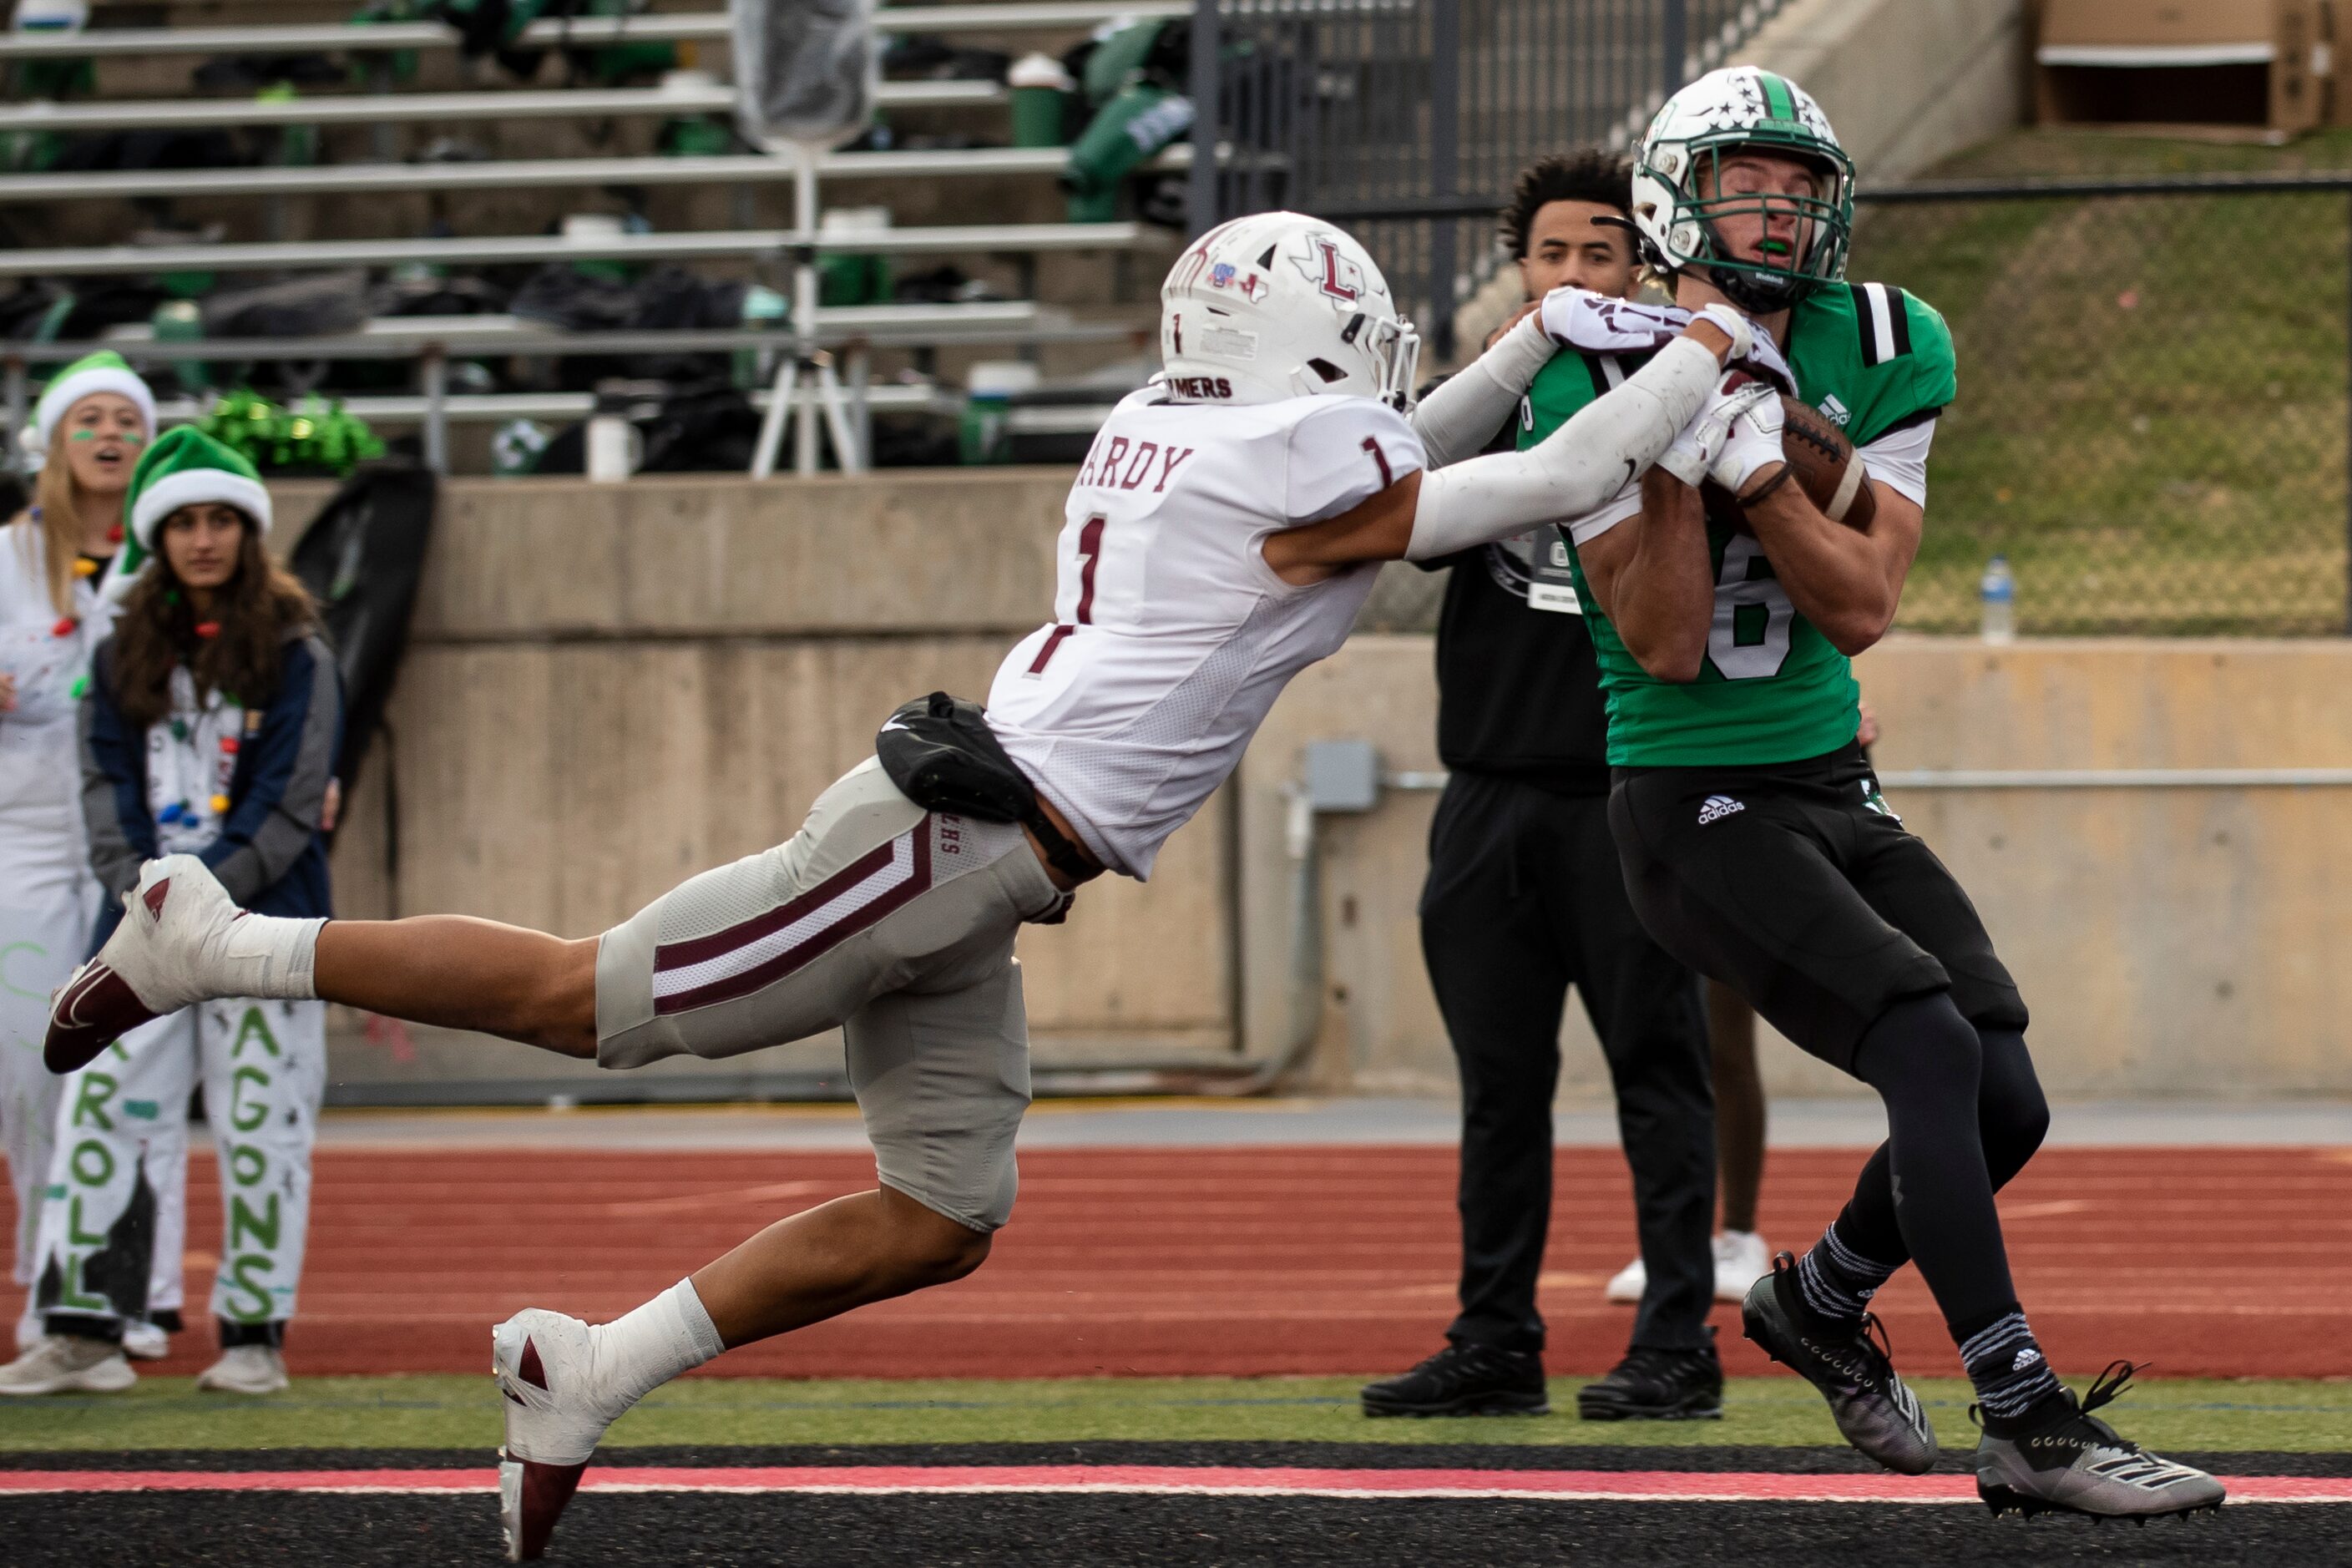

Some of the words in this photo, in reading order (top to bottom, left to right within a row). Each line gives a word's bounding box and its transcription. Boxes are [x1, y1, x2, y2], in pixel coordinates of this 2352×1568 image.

[1318, 240, 1358, 301] L
[1172, 312, 1182, 355] 1
[1168, 377, 1233, 399] MERS
[1358, 435, 1393, 488] 1
[1707, 534, 1795, 680] 6
[1697, 802, 1745, 824] adidas
